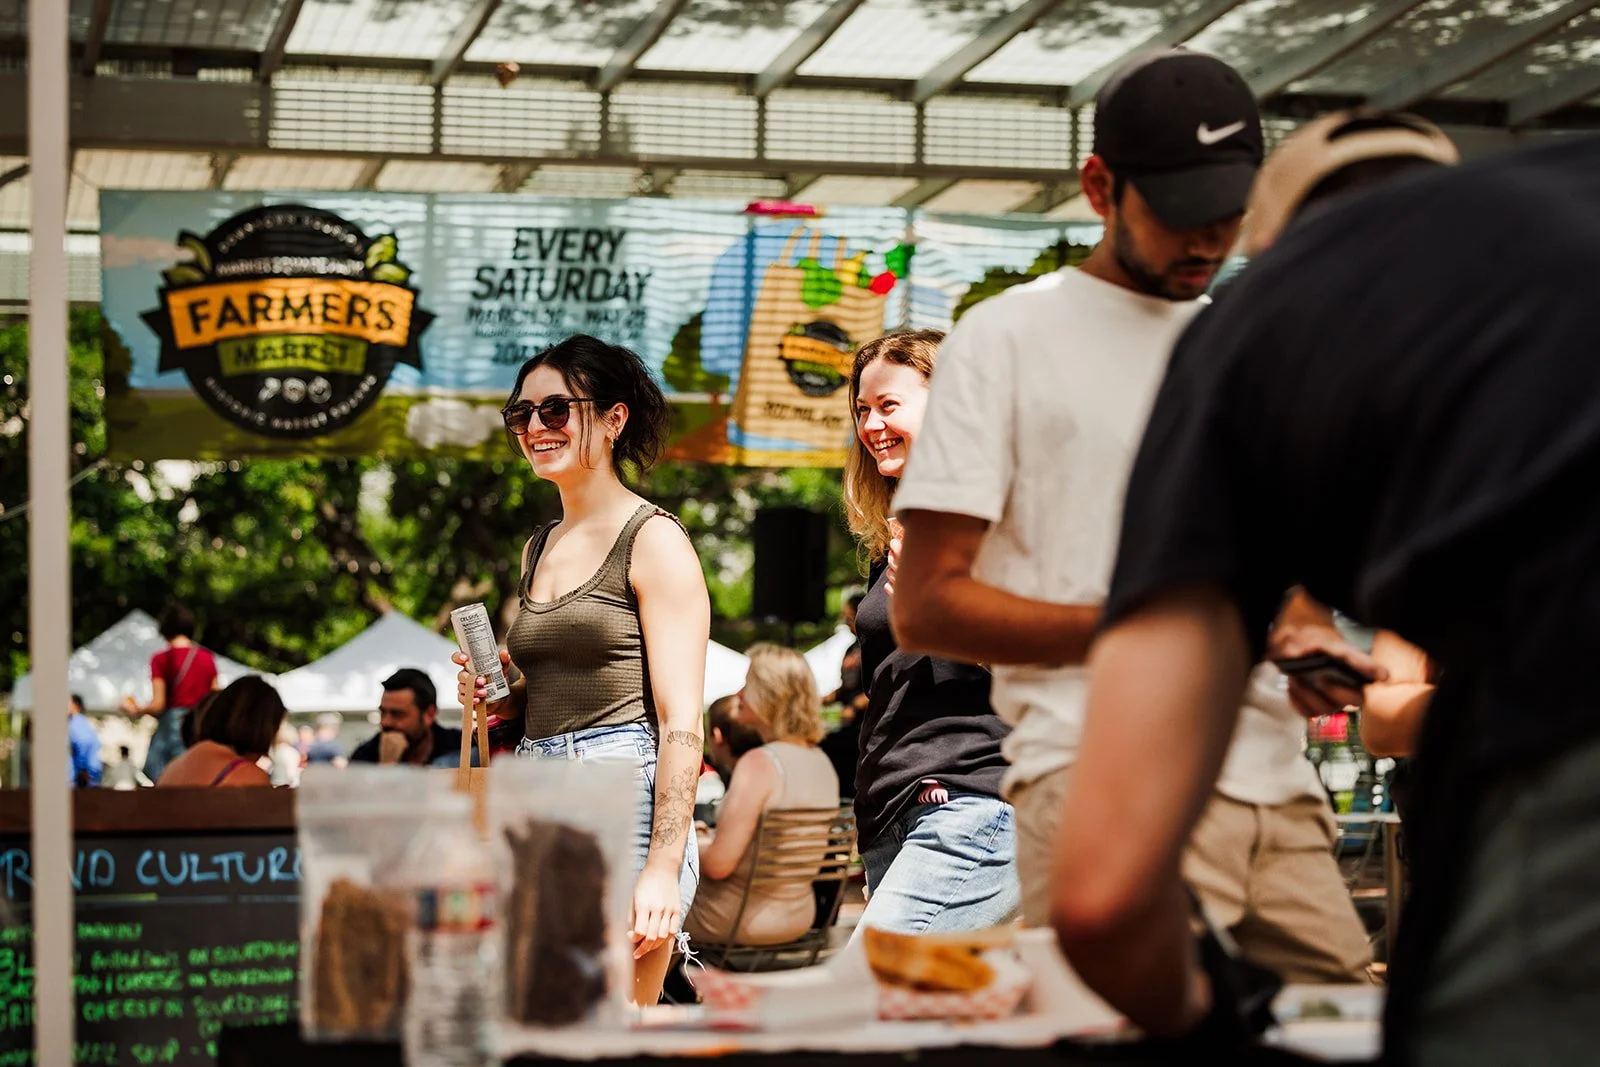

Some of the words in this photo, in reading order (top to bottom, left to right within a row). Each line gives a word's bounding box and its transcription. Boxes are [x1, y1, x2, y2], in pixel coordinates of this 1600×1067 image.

[512, 227, 626, 263] EVERY
[471, 266, 652, 303] SATURDAY
[187, 292, 397, 335] FARMERS
[233, 342, 350, 367] MARKET
